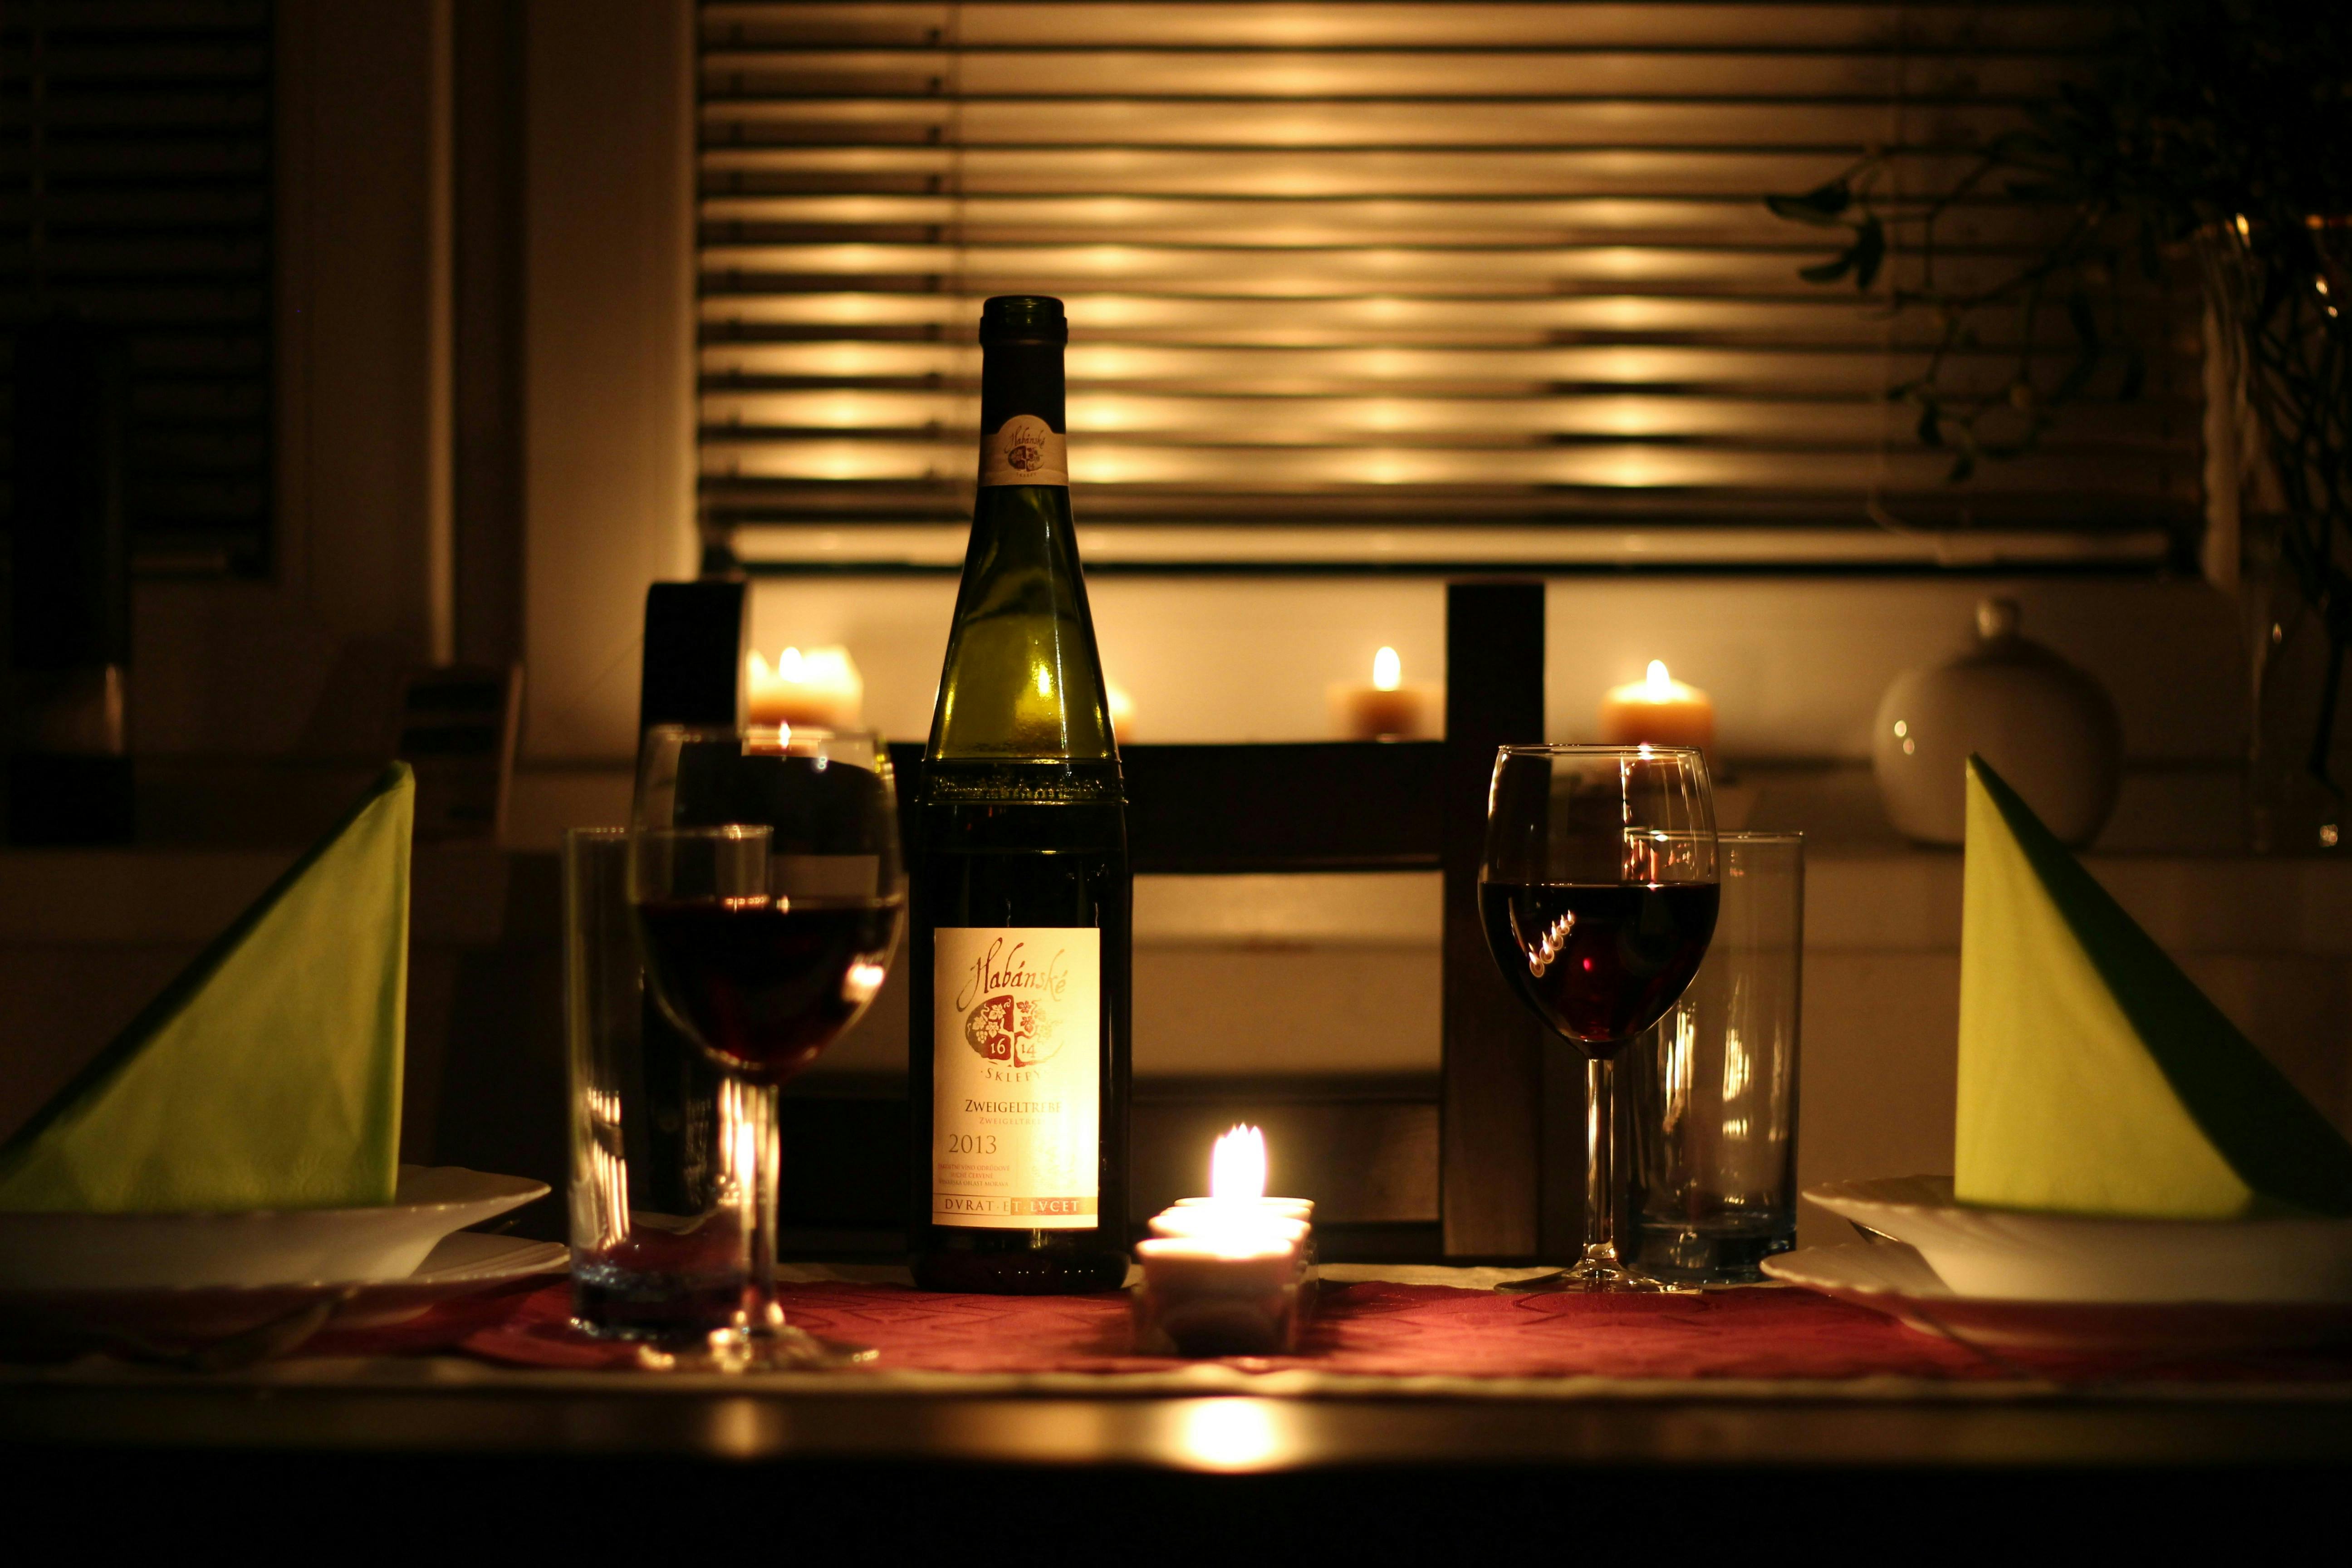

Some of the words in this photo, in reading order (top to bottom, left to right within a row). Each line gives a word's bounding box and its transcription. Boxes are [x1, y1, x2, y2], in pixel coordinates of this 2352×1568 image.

[1004, 426, 1045, 453] Habánské
[956, 937, 1068, 1012] Habánské
[990, 1038, 1006, 1054] 16
[1021, 1044, 1037, 1058] 14
[948, 1134, 997, 1154] 2013
[945, 1198, 994, 1211] DVRAT
